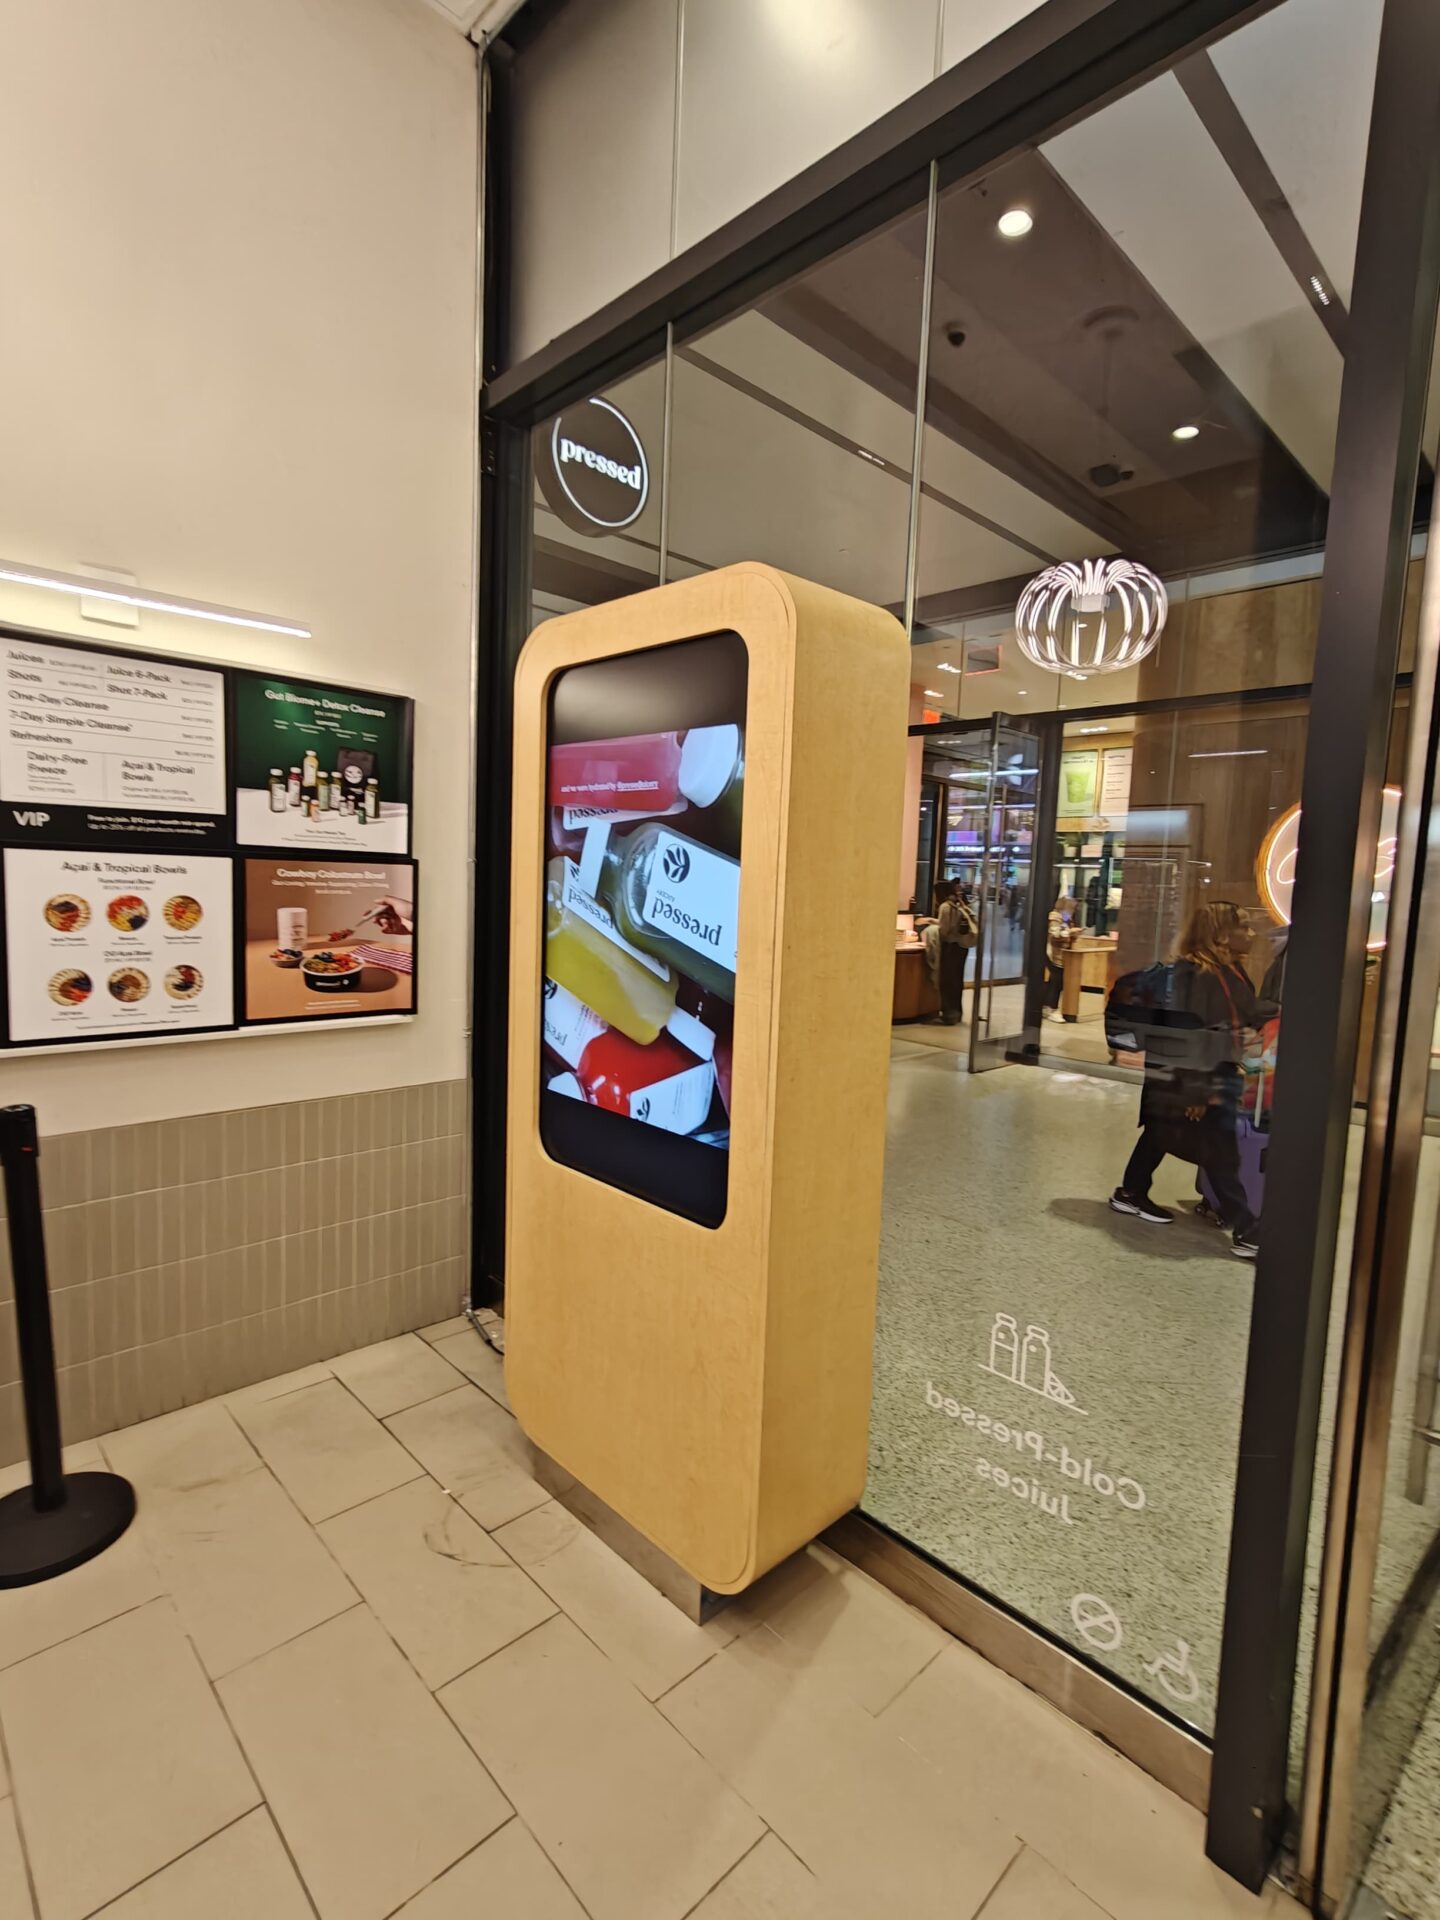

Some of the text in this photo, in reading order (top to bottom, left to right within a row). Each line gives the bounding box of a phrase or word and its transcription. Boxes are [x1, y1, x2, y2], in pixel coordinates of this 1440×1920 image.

[560, 438, 641, 490] pressed
[7, 650, 45, 663] Juices
[7, 669, 42, 682] Shots
[107, 665, 133, 677] Juice
[135, 670, 171, 683] 6-Pack
[107, 684, 131, 695] Shot
[8, 690, 109, 710] One-Day Cleanse
[46, 714, 84, 726] Simple
[27, 751, 88, 764] Dairy-Free
[156, 763, 195, 774] Tropical
[122, 772, 154, 781] Bowls
[13, 811, 50, 827] VIP
[93, 863, 101, 872] &
[104, 863, 150, 875] Tropical
[153, 865, 187, 874] Bowls
[651, 897, 722, 946] pressed
